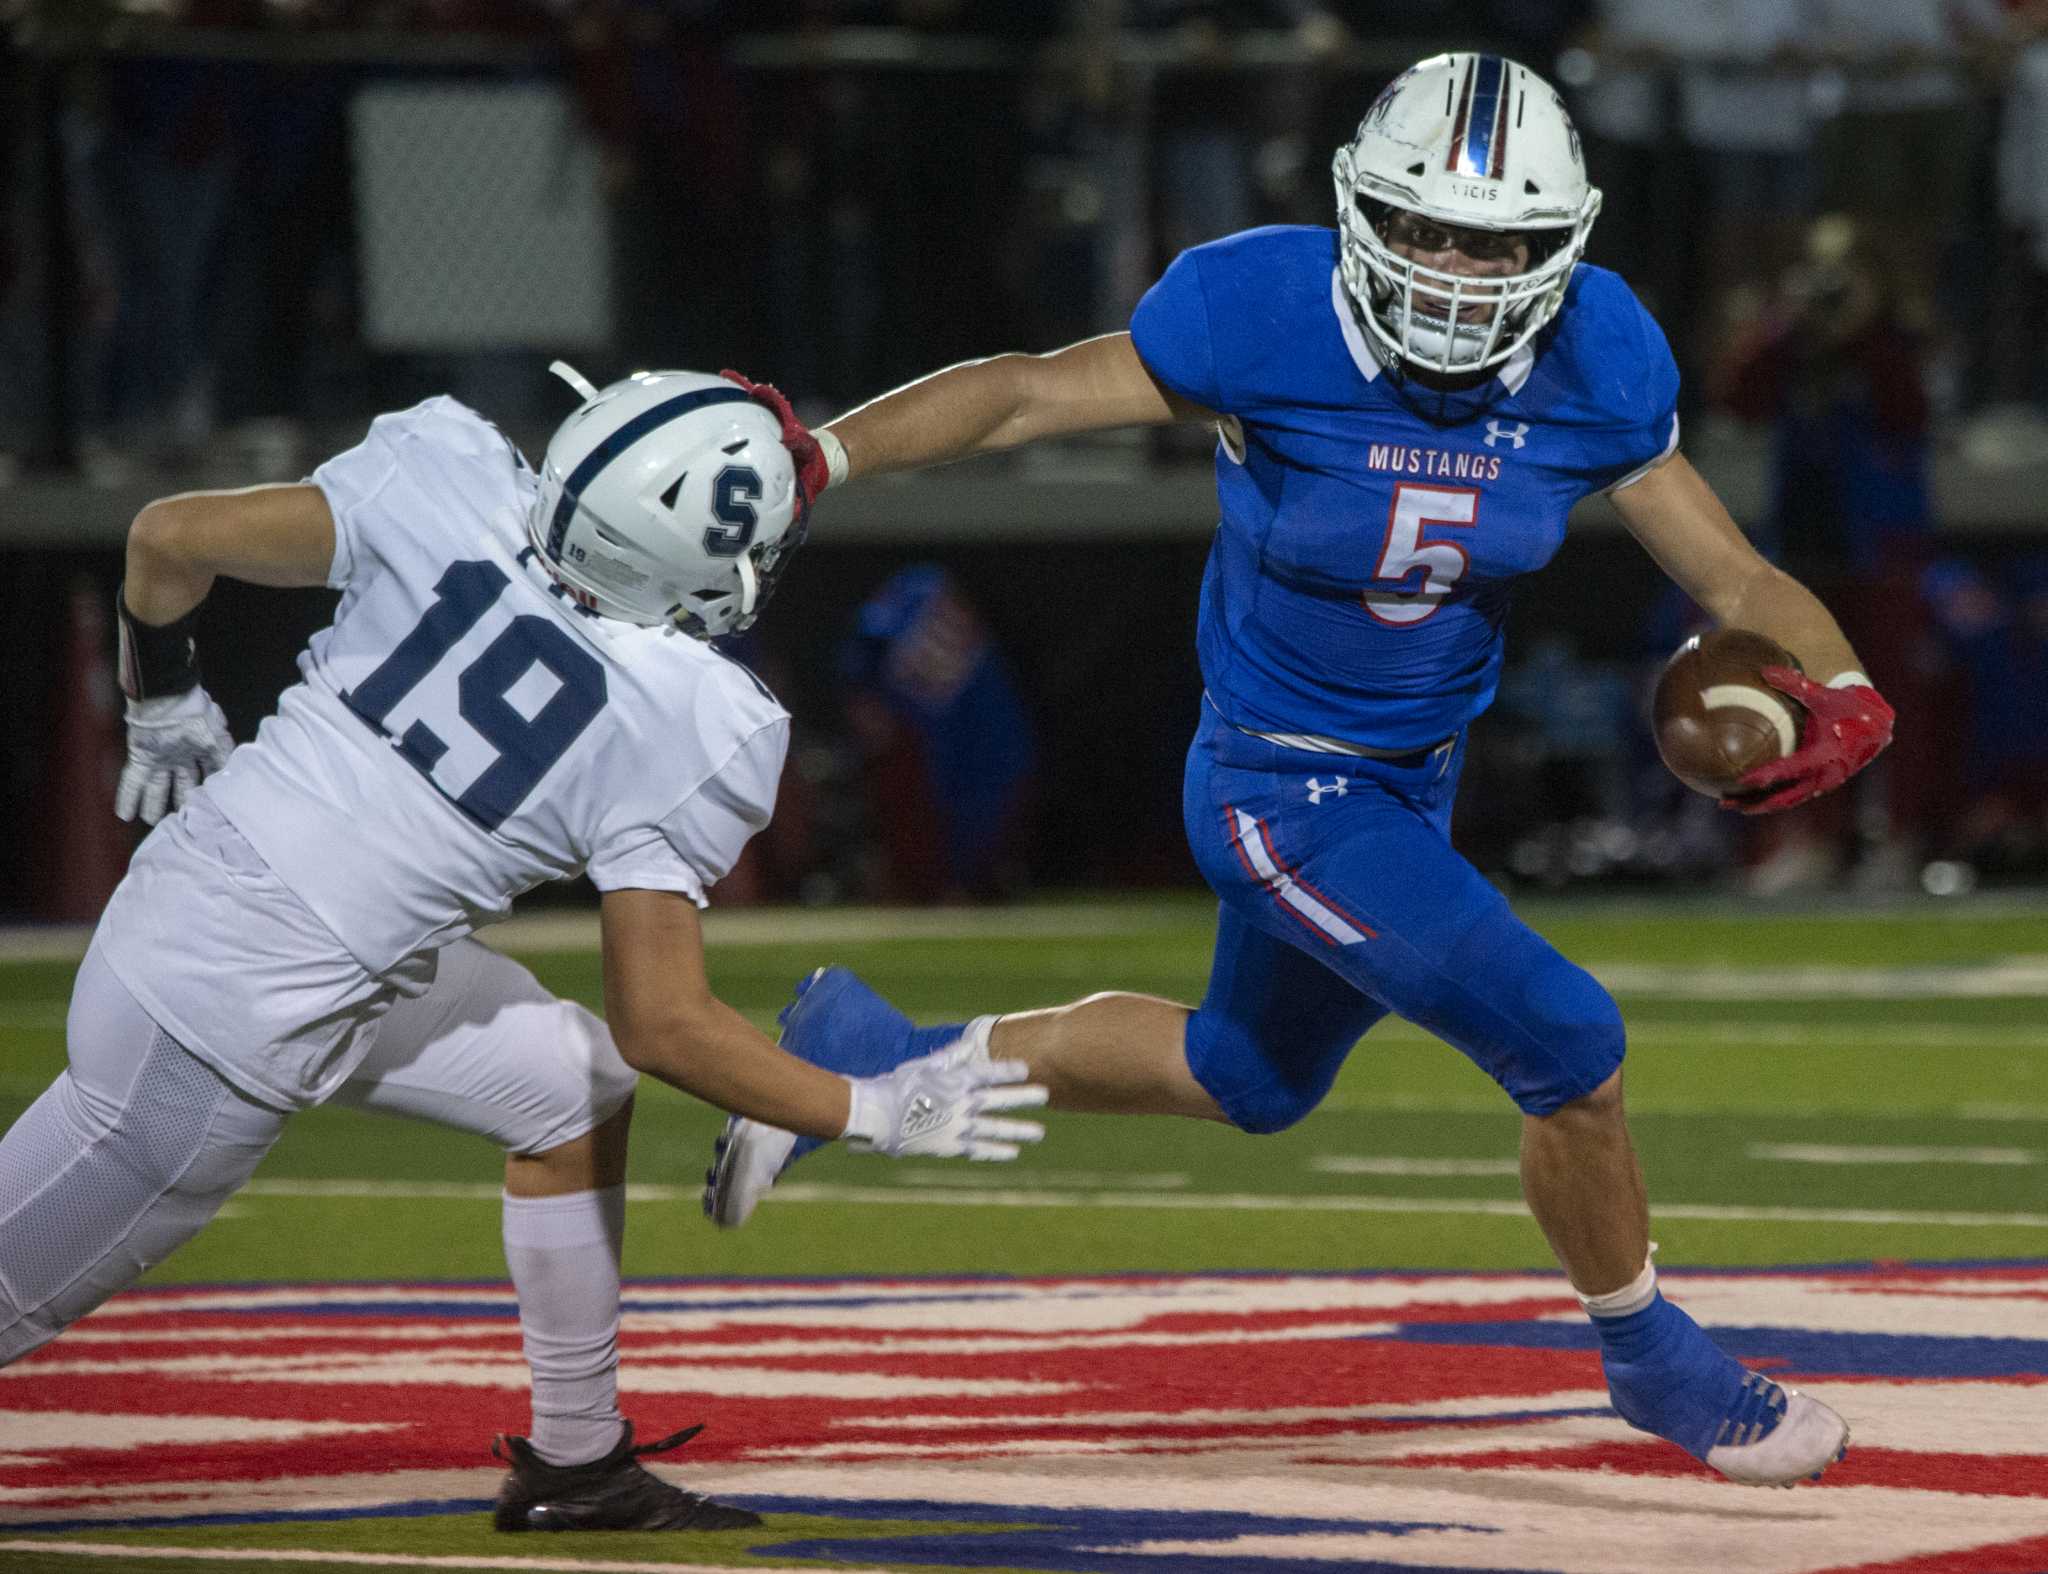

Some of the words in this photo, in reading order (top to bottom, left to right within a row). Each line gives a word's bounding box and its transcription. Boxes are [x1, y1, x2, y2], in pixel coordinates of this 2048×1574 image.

[702, 463, 763, 557] S
[1368, 444, 1501, 481] MUSTANGS
[1361, 480, 1482, 628] 5
[339, 559, 609, 834] 19
